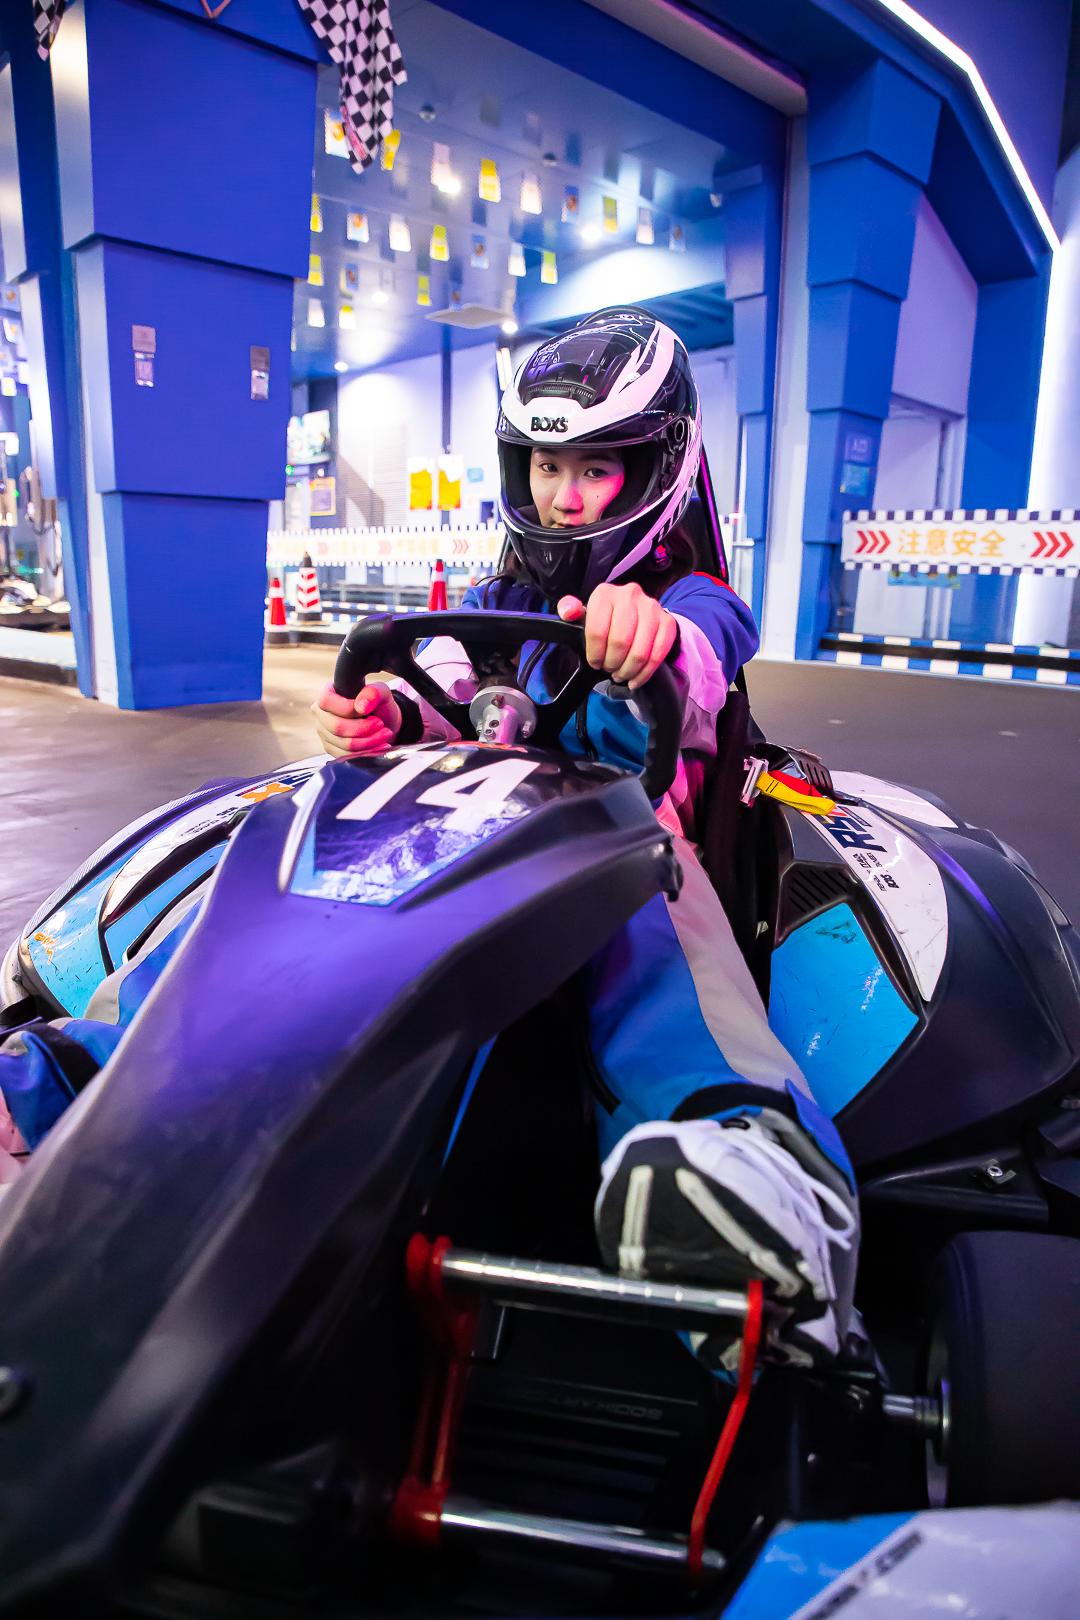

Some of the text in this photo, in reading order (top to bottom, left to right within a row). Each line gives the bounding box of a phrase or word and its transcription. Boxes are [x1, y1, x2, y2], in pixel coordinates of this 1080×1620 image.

[899, 529, 1005, 557] 注意安全
[336, 750, 540, 832] 14
